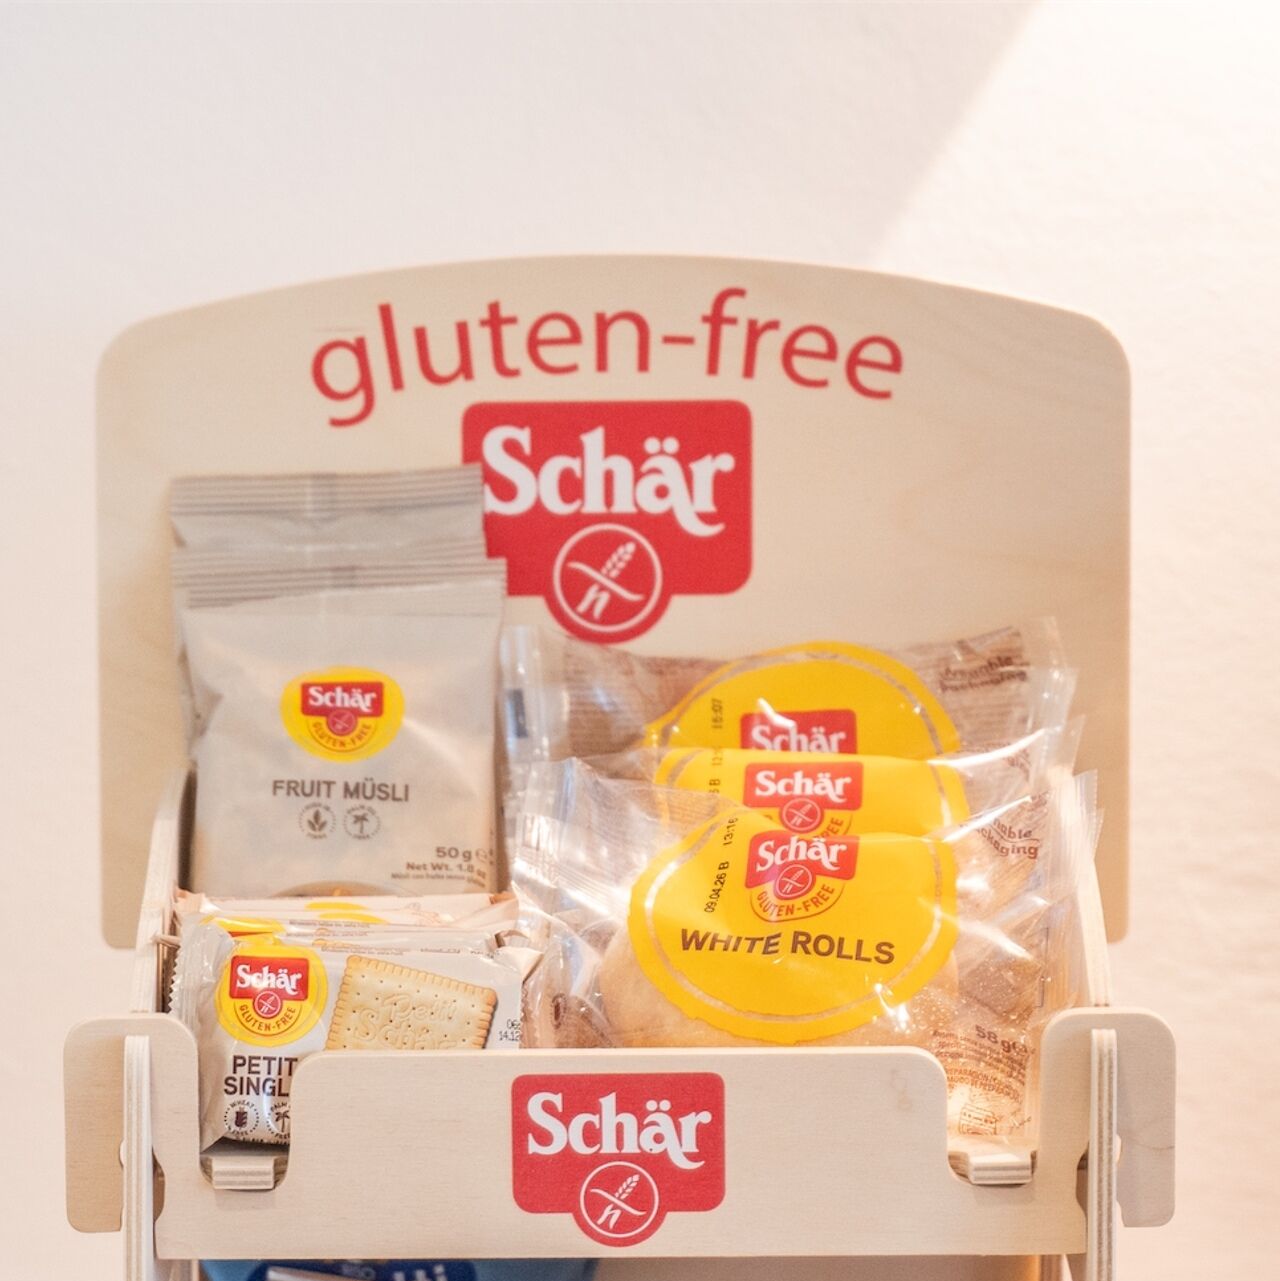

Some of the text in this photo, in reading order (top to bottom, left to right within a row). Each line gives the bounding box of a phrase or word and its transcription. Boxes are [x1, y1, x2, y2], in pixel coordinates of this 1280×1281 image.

[310, 287, 904, 428] gluten-free
[481, 425, 735, 537] Schär
[308, 685, 377, 713] Schär
[272, 777, 410, 802] FRUIT MÜSLI
[755, 771, 852, 804] Schär
[435, 846, 460, 859] 50
[756, 834, 848, 872] Schär
[757, 884, 835, 917] GLUTEN-FREE
[680, 928, 895, 965] WHITE ROLLS
[236, 964, 303, 996] Schär
[239, 1004, 297, 1032] GLUTEN-FREE
[232, 1055, 298, 1076] PETIT
[526, 1092, 712, 1170] Schär
